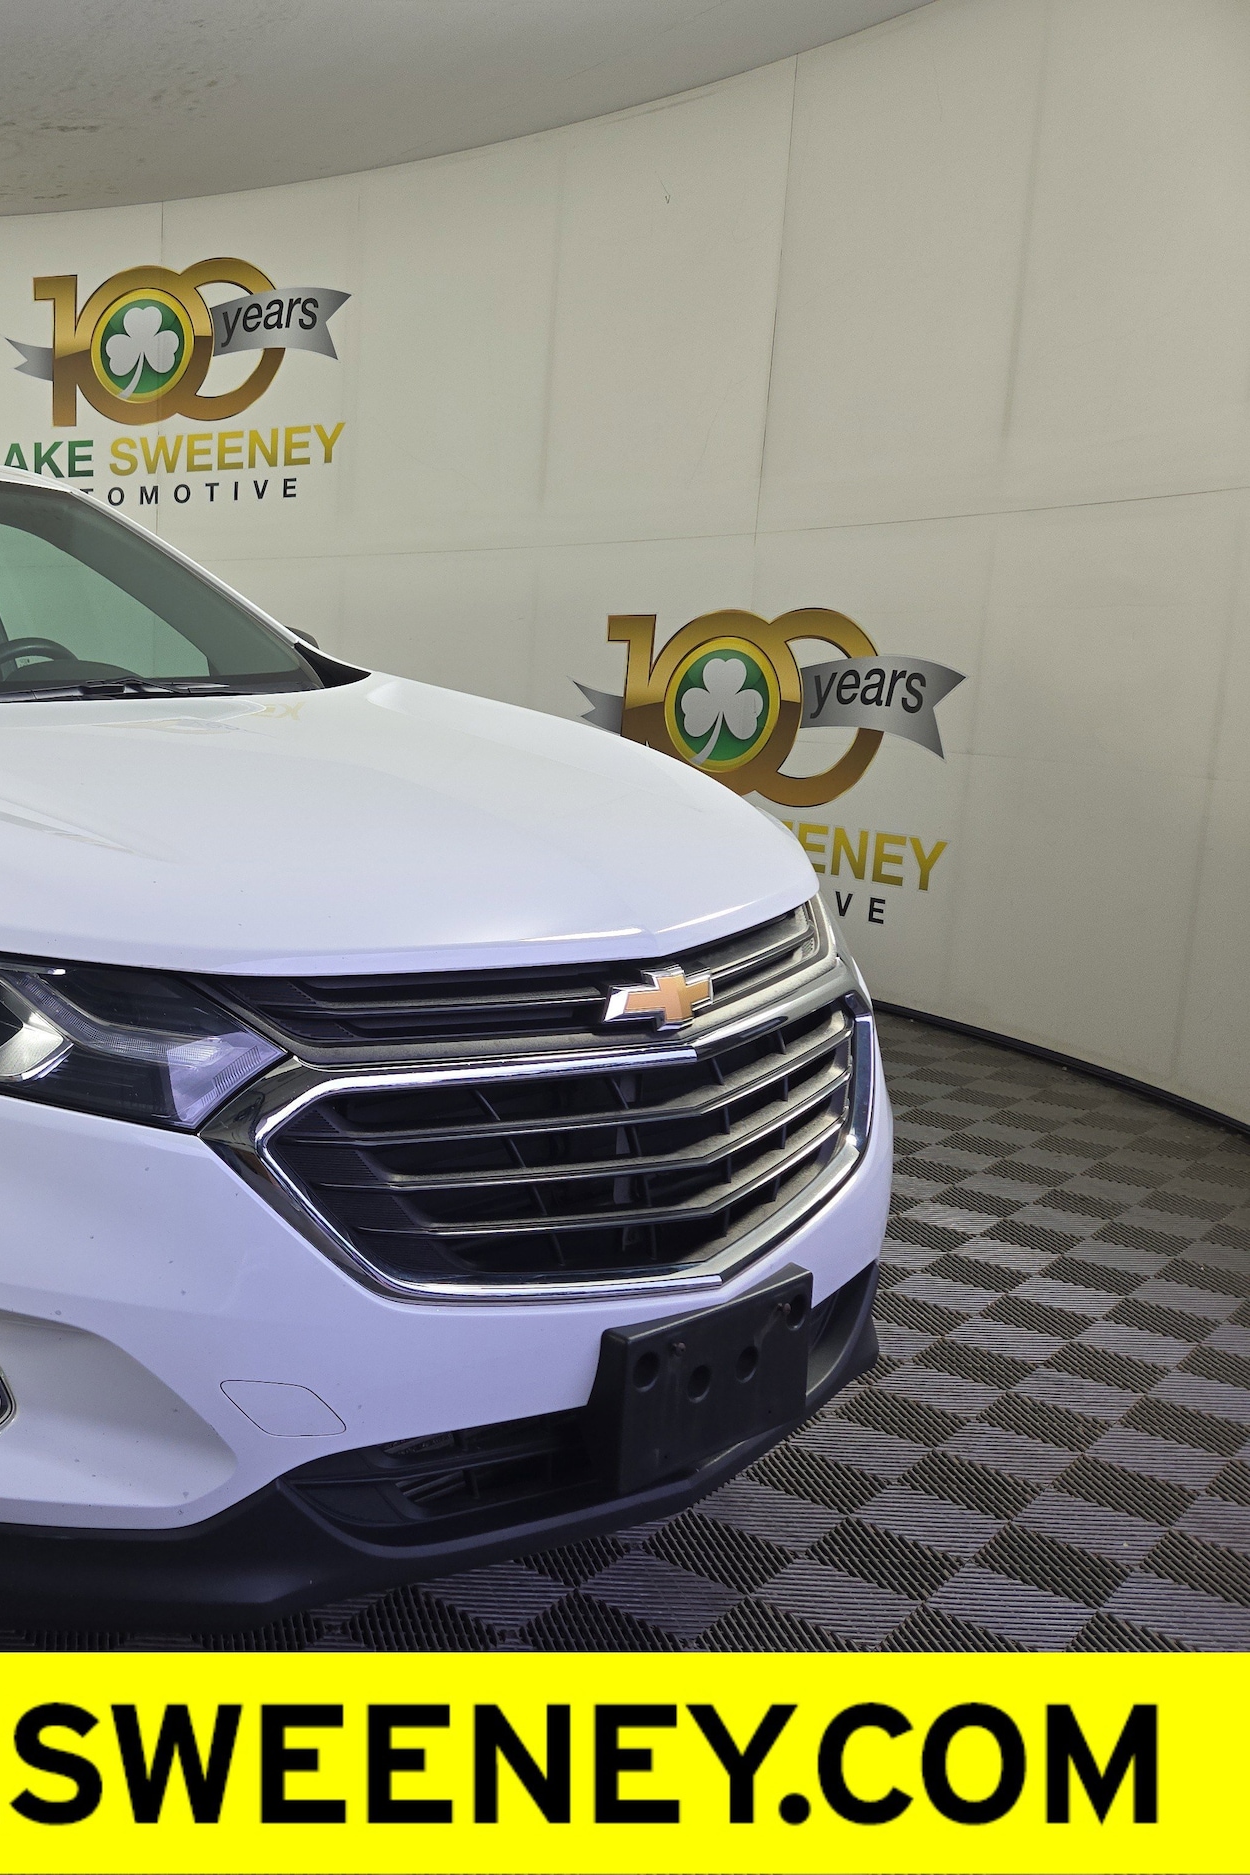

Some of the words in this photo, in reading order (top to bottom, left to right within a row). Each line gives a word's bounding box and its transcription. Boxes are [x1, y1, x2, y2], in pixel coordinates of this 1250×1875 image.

[33, 257, 286, 427] 100
[220, 296, 319, 348] years
[109, 422, 346, 476] SWEENEY
[79, 477, 298, 506] OMOTIVE
[809, 667, 927, 719] years
[781, 821, 947, 892] ENEY
